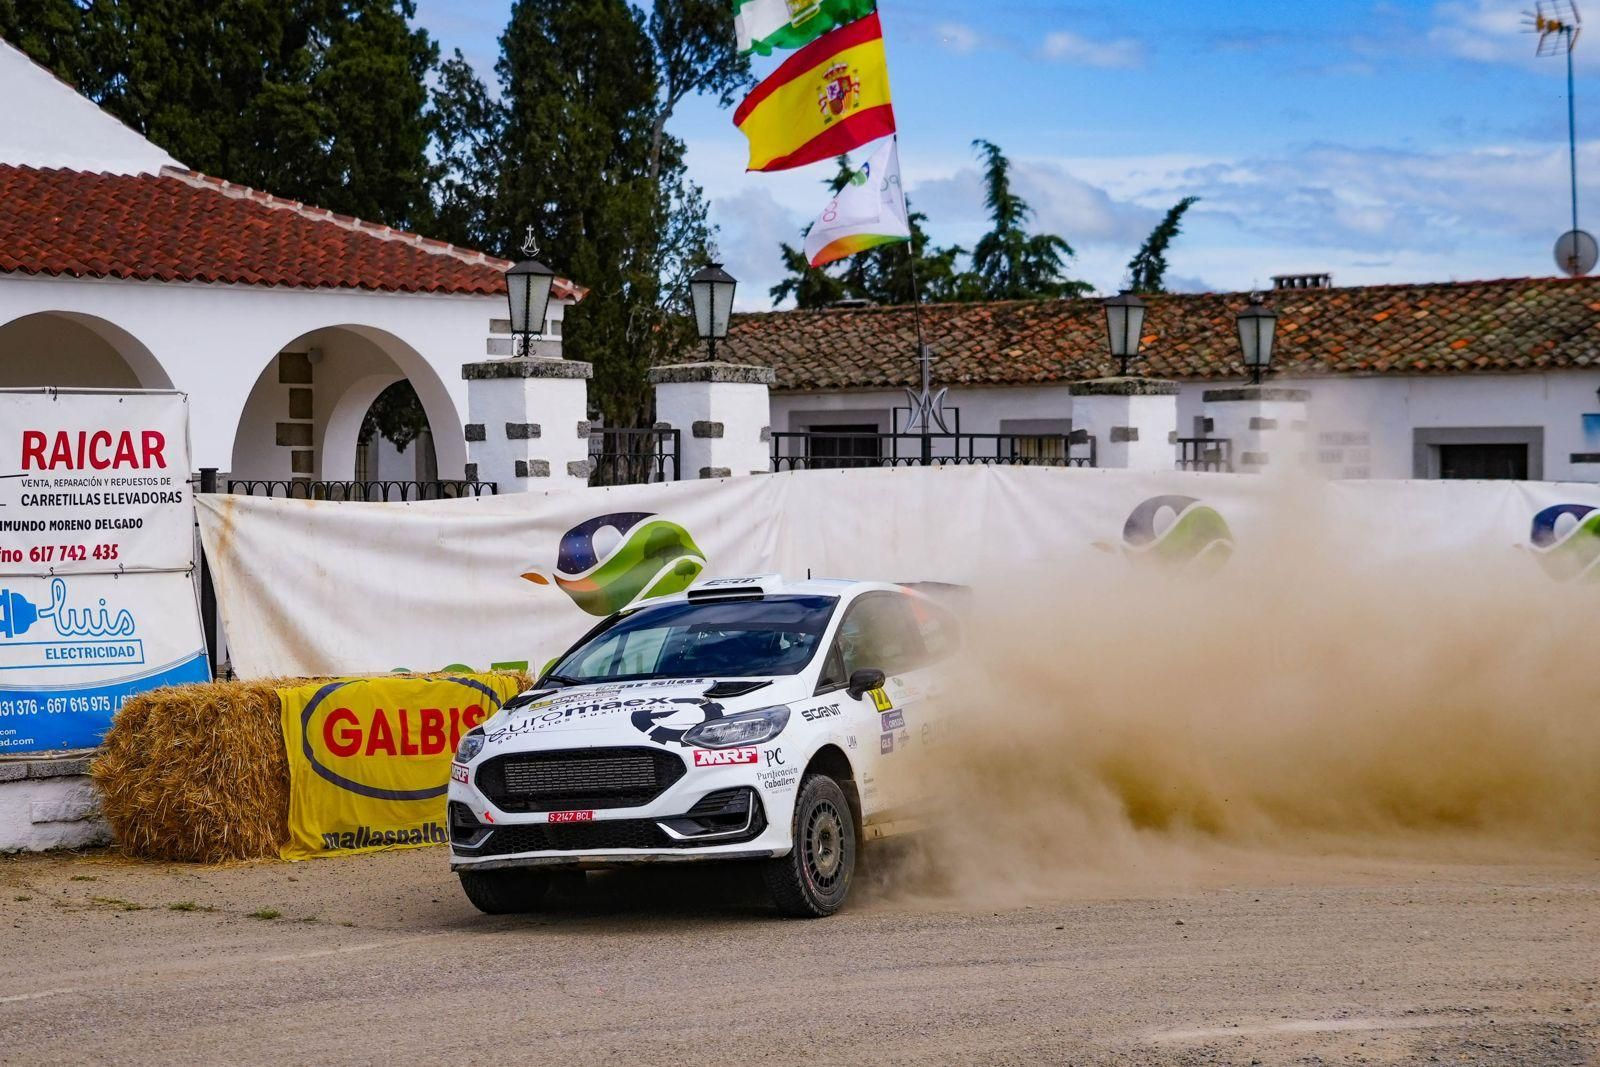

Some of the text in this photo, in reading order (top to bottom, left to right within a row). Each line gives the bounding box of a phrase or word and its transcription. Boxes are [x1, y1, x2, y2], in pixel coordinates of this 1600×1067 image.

[21, 430, 167, 470] RAICAR
[21, 476, 171, 489] VENTA, REPARACIÓN Y REPUESTOS DE
[21, 491, 182, 506] CARRETILLAS ELEVADORAS
[49, 519, 91, 530] MORENO
[95, 518, 143, 530] DELGADO
[0, 544, 119, 562] no 617 742 435
[45, 645, 135, 660] ELECTRICIDAD
[17, 699, 38, 715] 376
[47, 697, 67, 713] 667
[70, 697, 89, 712] 615
[91, 696, 110, 711] 975
[697, 748, 757, 765] MRF
[764, 747, 785, 767] PC
[549, 811, 590, 821] S 2147 BCL
